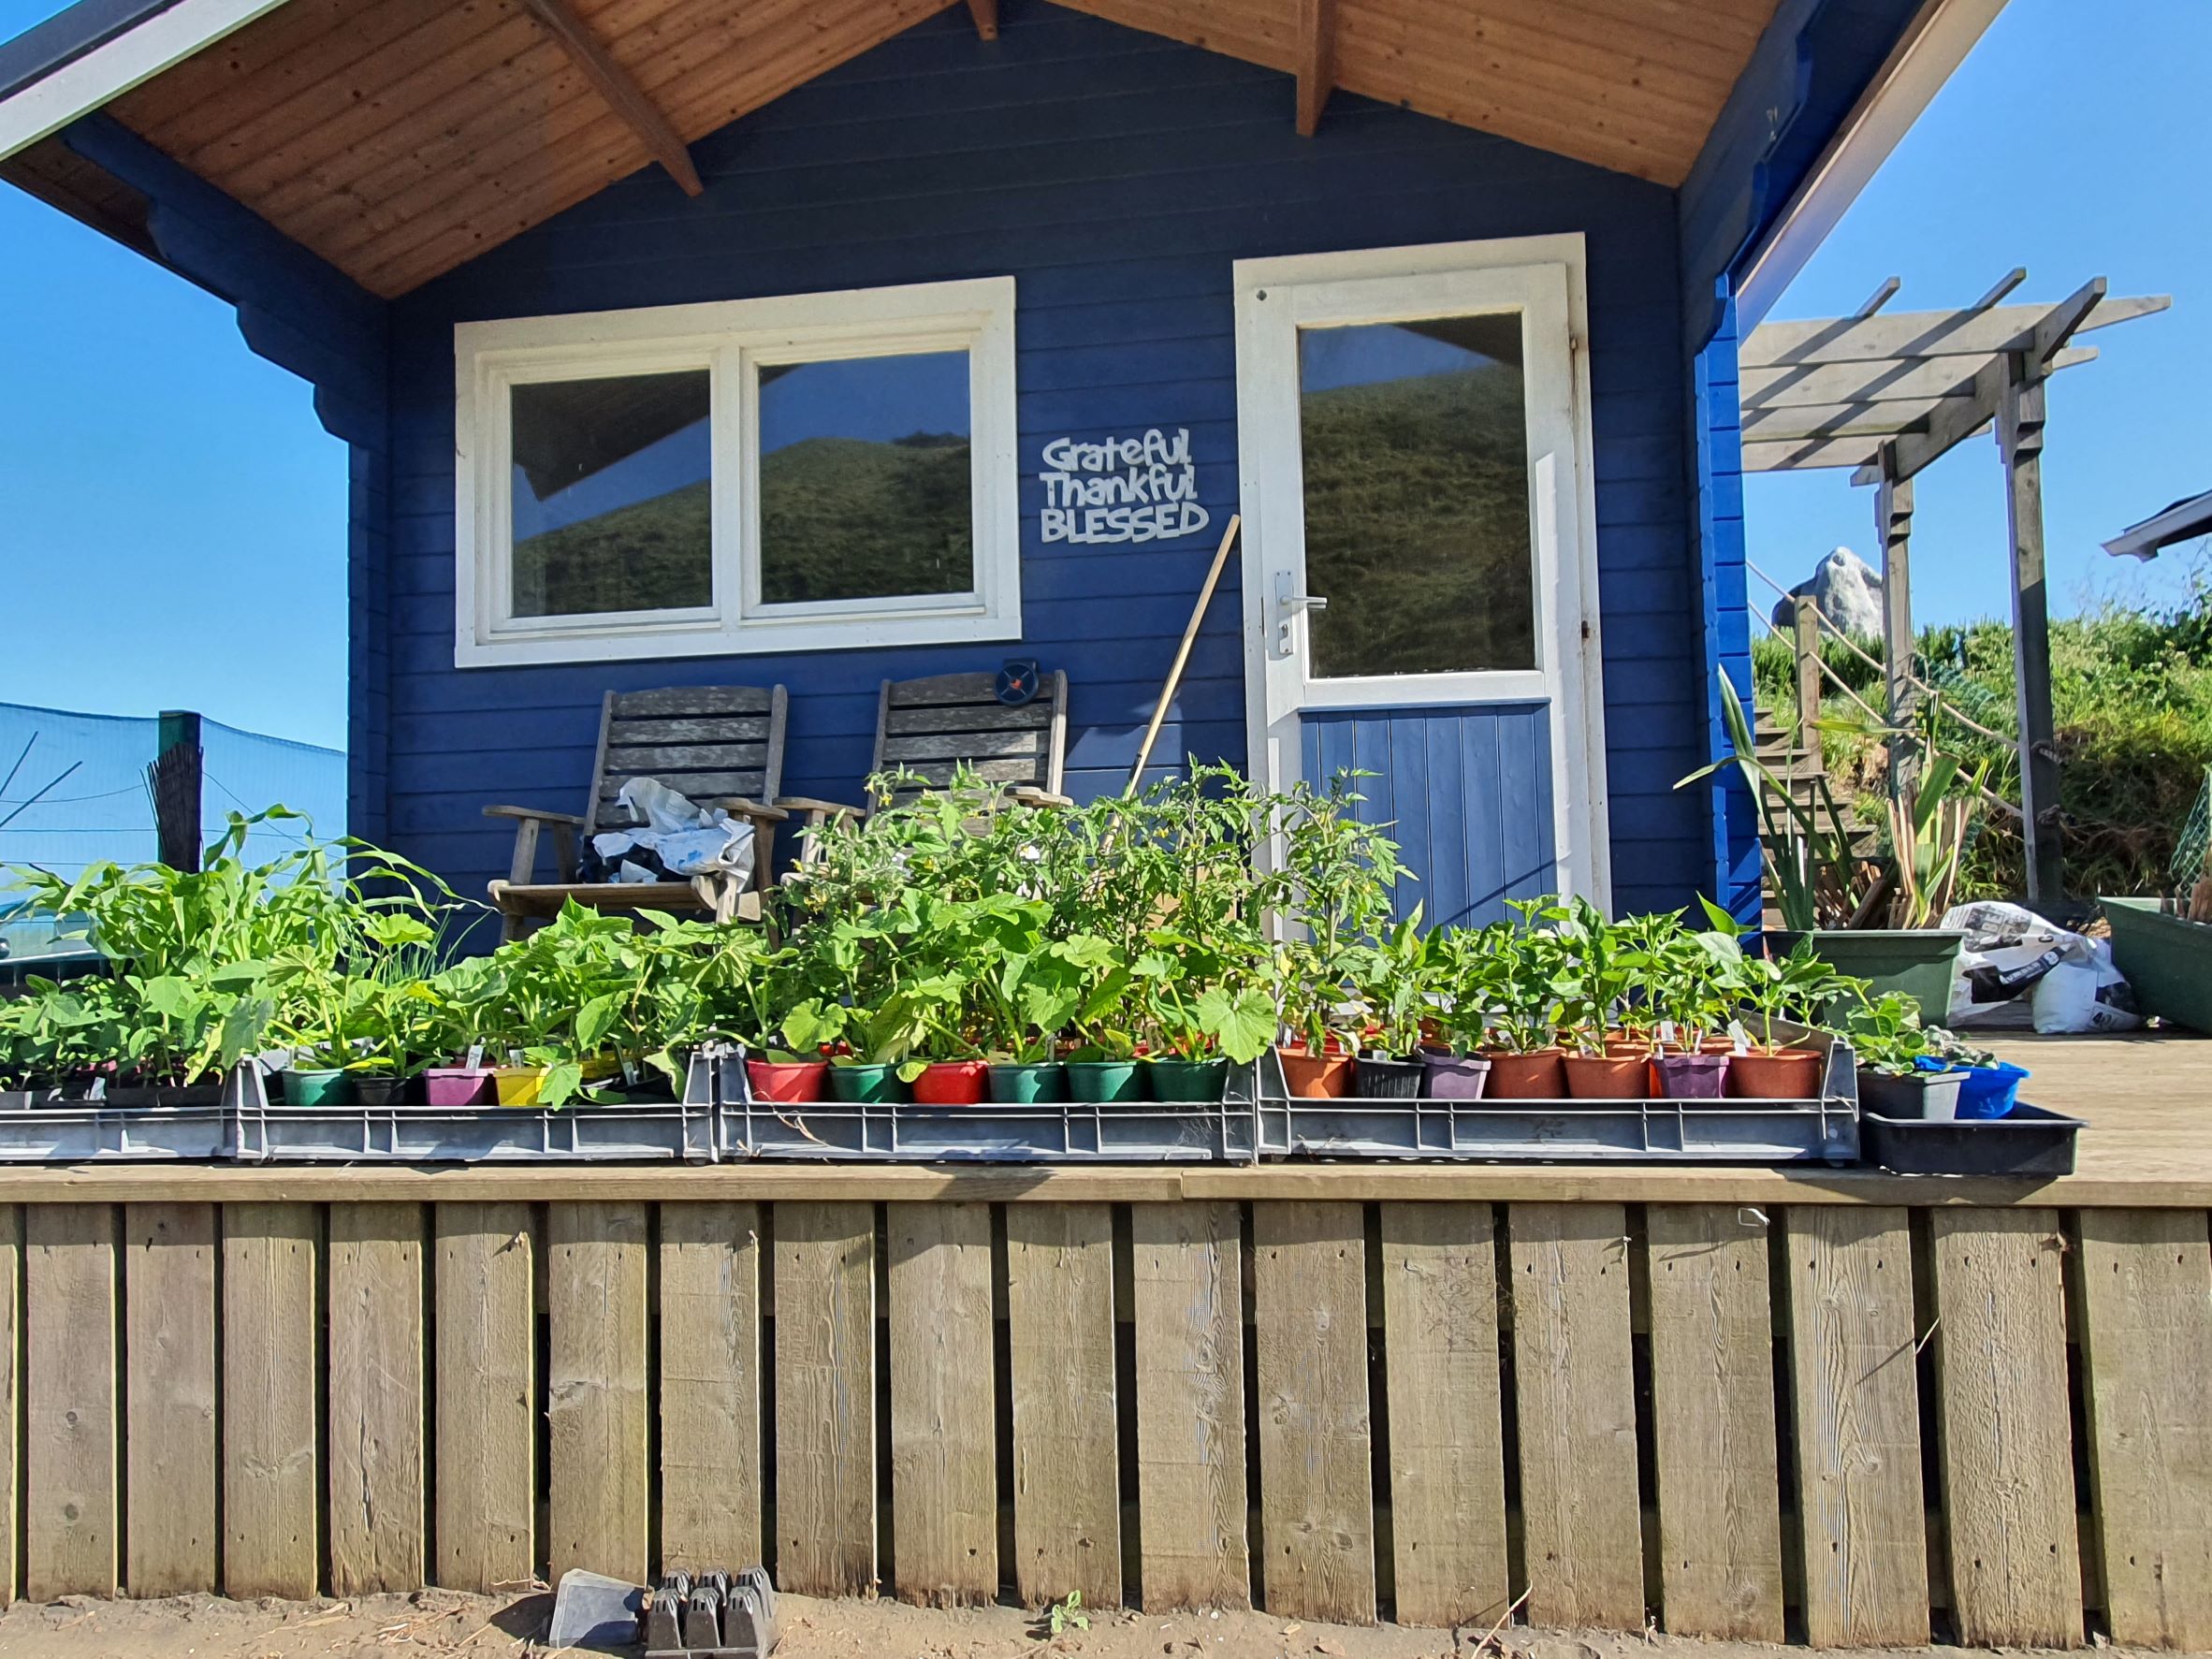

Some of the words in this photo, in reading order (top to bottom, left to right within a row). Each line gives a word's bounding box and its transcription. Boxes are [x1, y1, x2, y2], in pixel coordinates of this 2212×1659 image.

[1041, 428, 1192, 472] Grateful
[1039, 463, 1198, 507] Thankful
[1041, 502, 1210, 544] BLESSED
